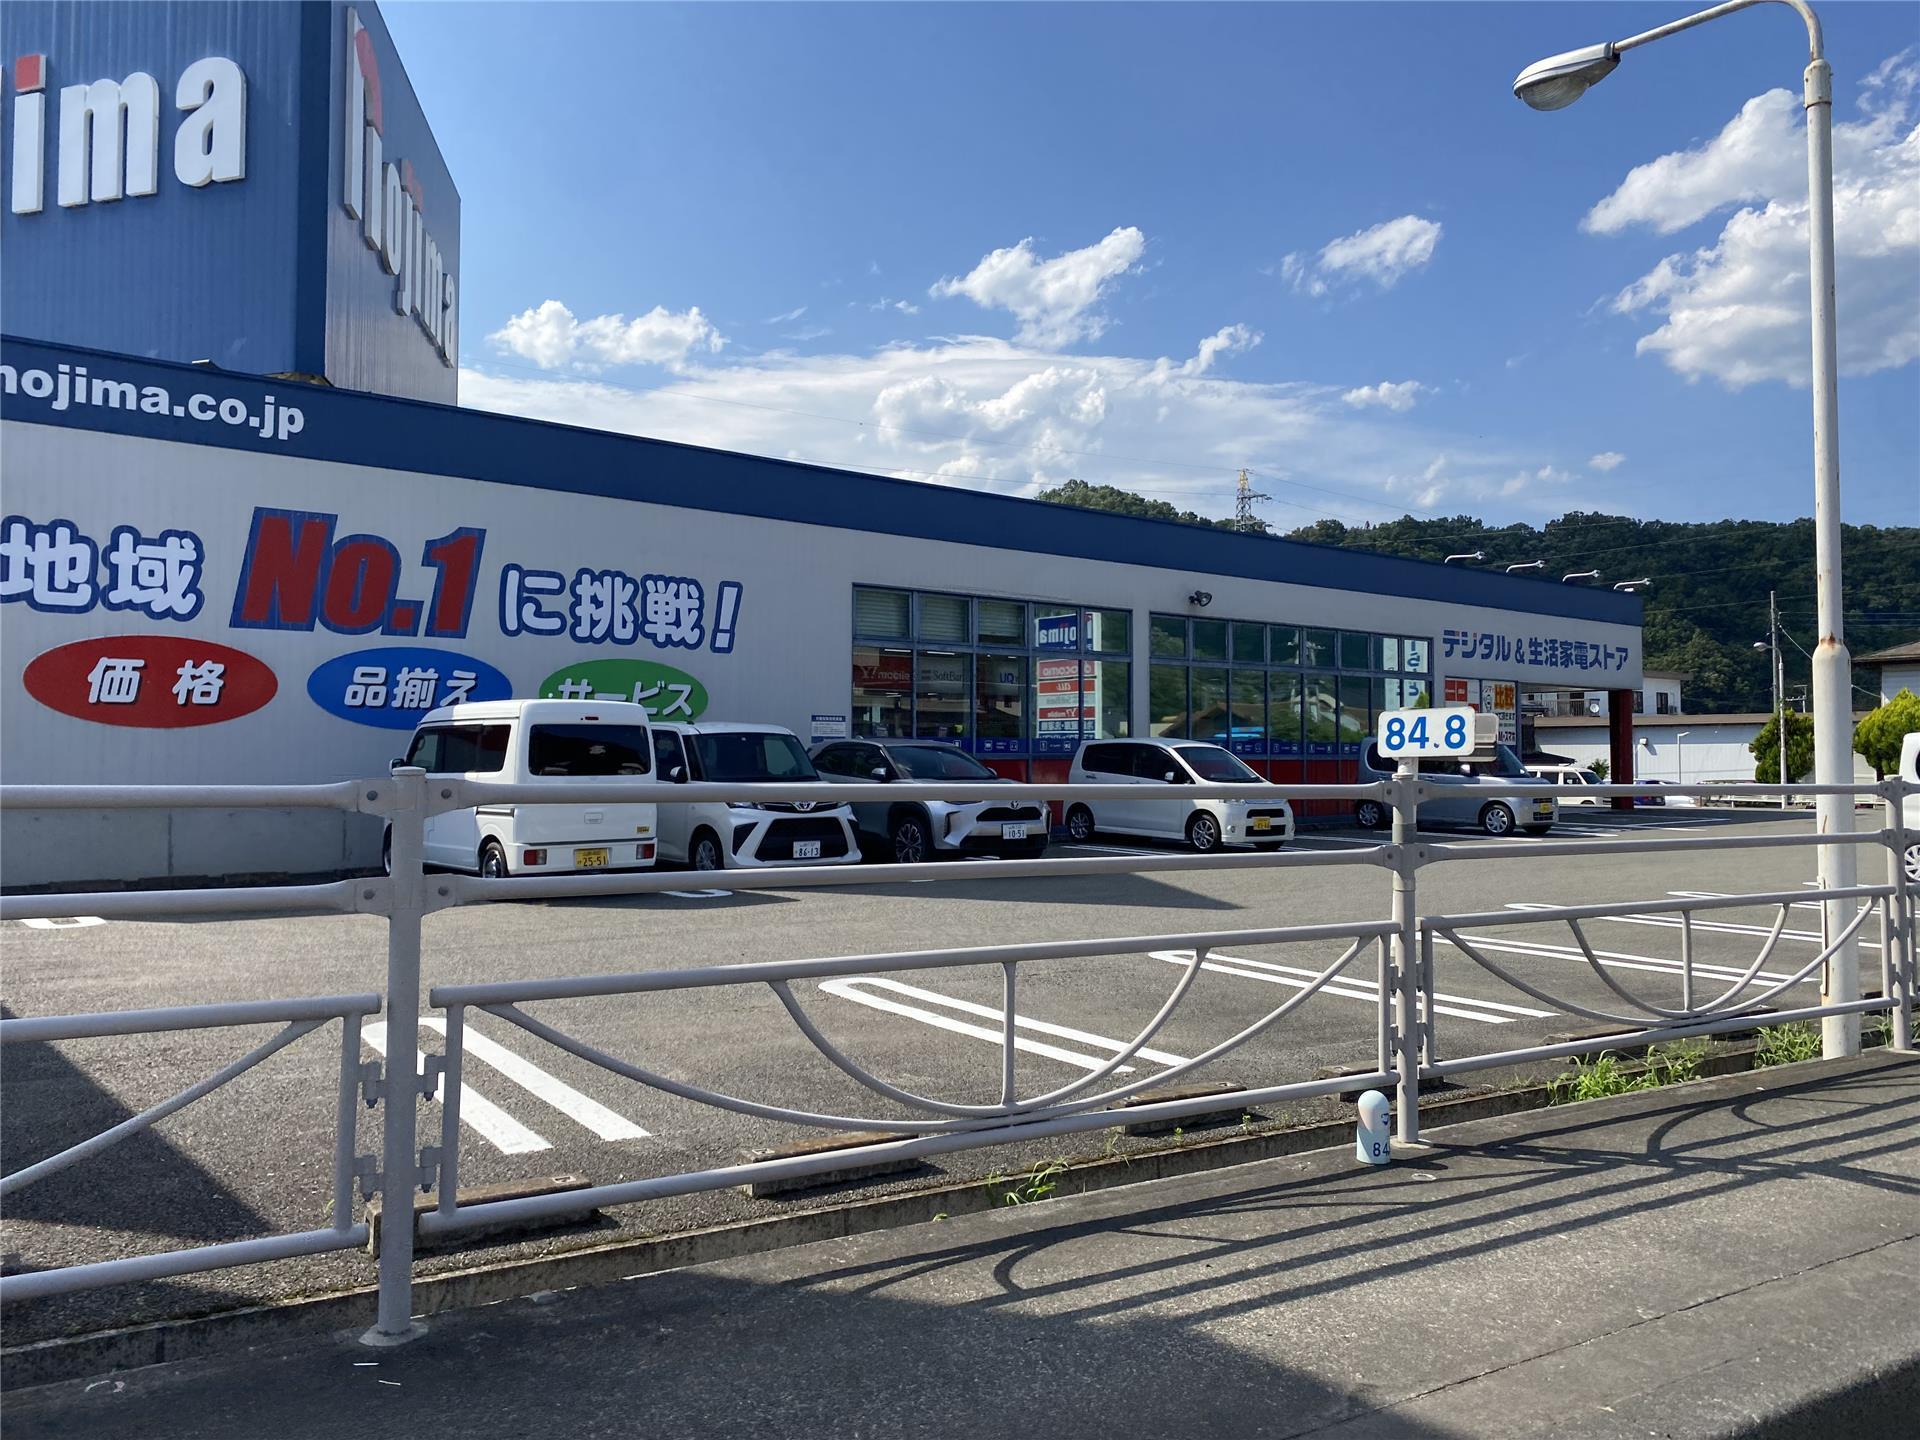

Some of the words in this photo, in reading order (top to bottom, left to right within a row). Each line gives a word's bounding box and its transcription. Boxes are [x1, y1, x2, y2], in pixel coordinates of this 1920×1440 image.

[0, 54, 246, 214] ima
[344, 6, 455, 368] nojima
[0, 363, 304, 440] nojima.co.jp
[0, 516, 205, 622] 地域
[230, 506, 487, 638] No.1
[88, 656, 226, 706] 価格
[343, 665, 478, 708] 品揃え
[1385, 714, 1466, 751] 84.8
